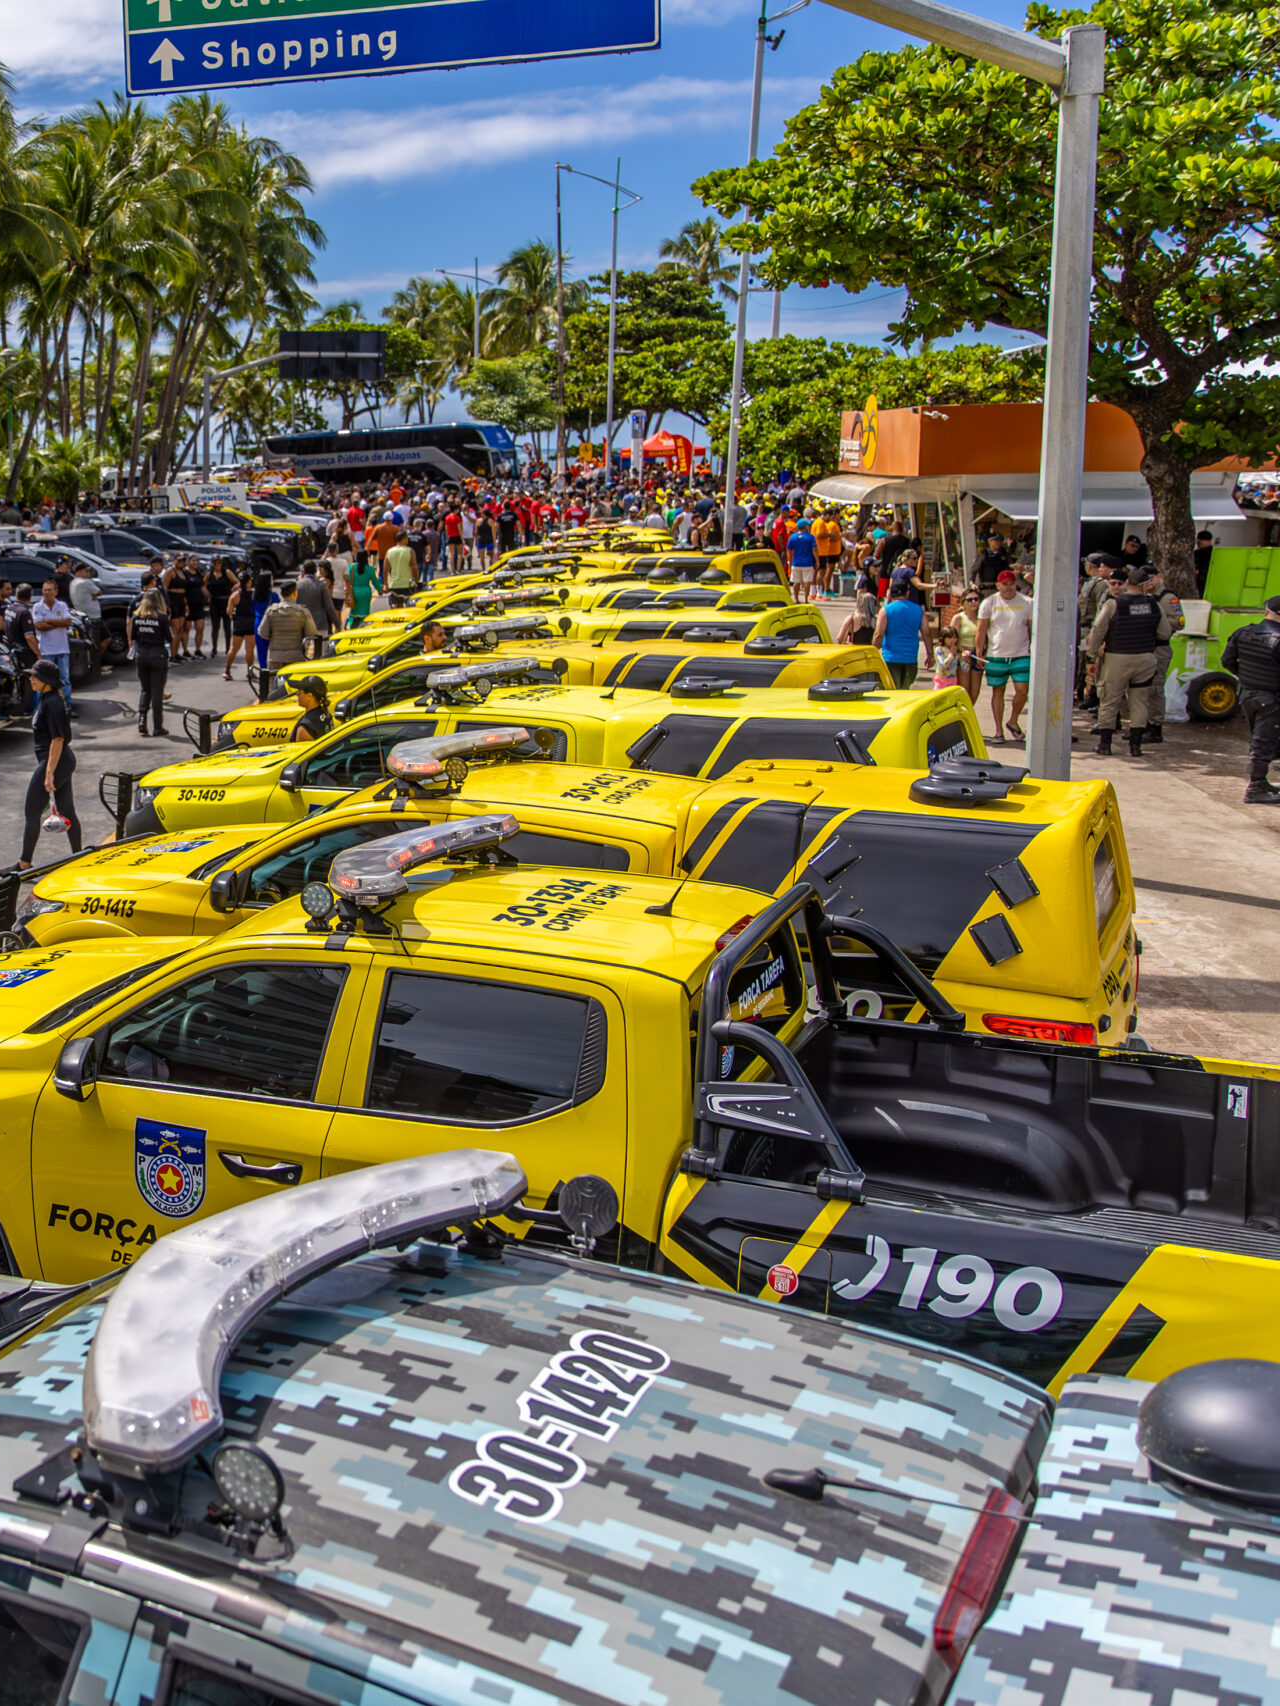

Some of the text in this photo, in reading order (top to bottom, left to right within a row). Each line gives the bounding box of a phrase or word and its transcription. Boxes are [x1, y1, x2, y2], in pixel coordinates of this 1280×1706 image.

[202, 29, 397, 70] Shopping
[292, 450, 421, 468] Segurança Pública de Alagoas
[195, 494, 237, 503] CIENTÍFICA
[135, 618, 160, 626] POLÍCIA
[252, 727, 288, 739] 30-1410
[177, 789, 226, 802] 30-1409
[80, 896, 138, 919] 30-1413
[491, 878, 598, 927] 30-1394
[542, 907, 594, 932] CPRM
[737, 954, 785, 1015] FORÇA TAREFA
[138, 1155, 146, 1166] P
[192, 1166, 202, 1178] M
[154, 1200, 188, 1214] ALAGOAS
[48, 1203, 158, 1248] FORÇA
[111, 1249, 133, 1266] DE
[775, 1281, 789, 1292] S10
[898, 1247, 1064, 1332] 190
[449, 1329, 670, 1524] 30-1420
